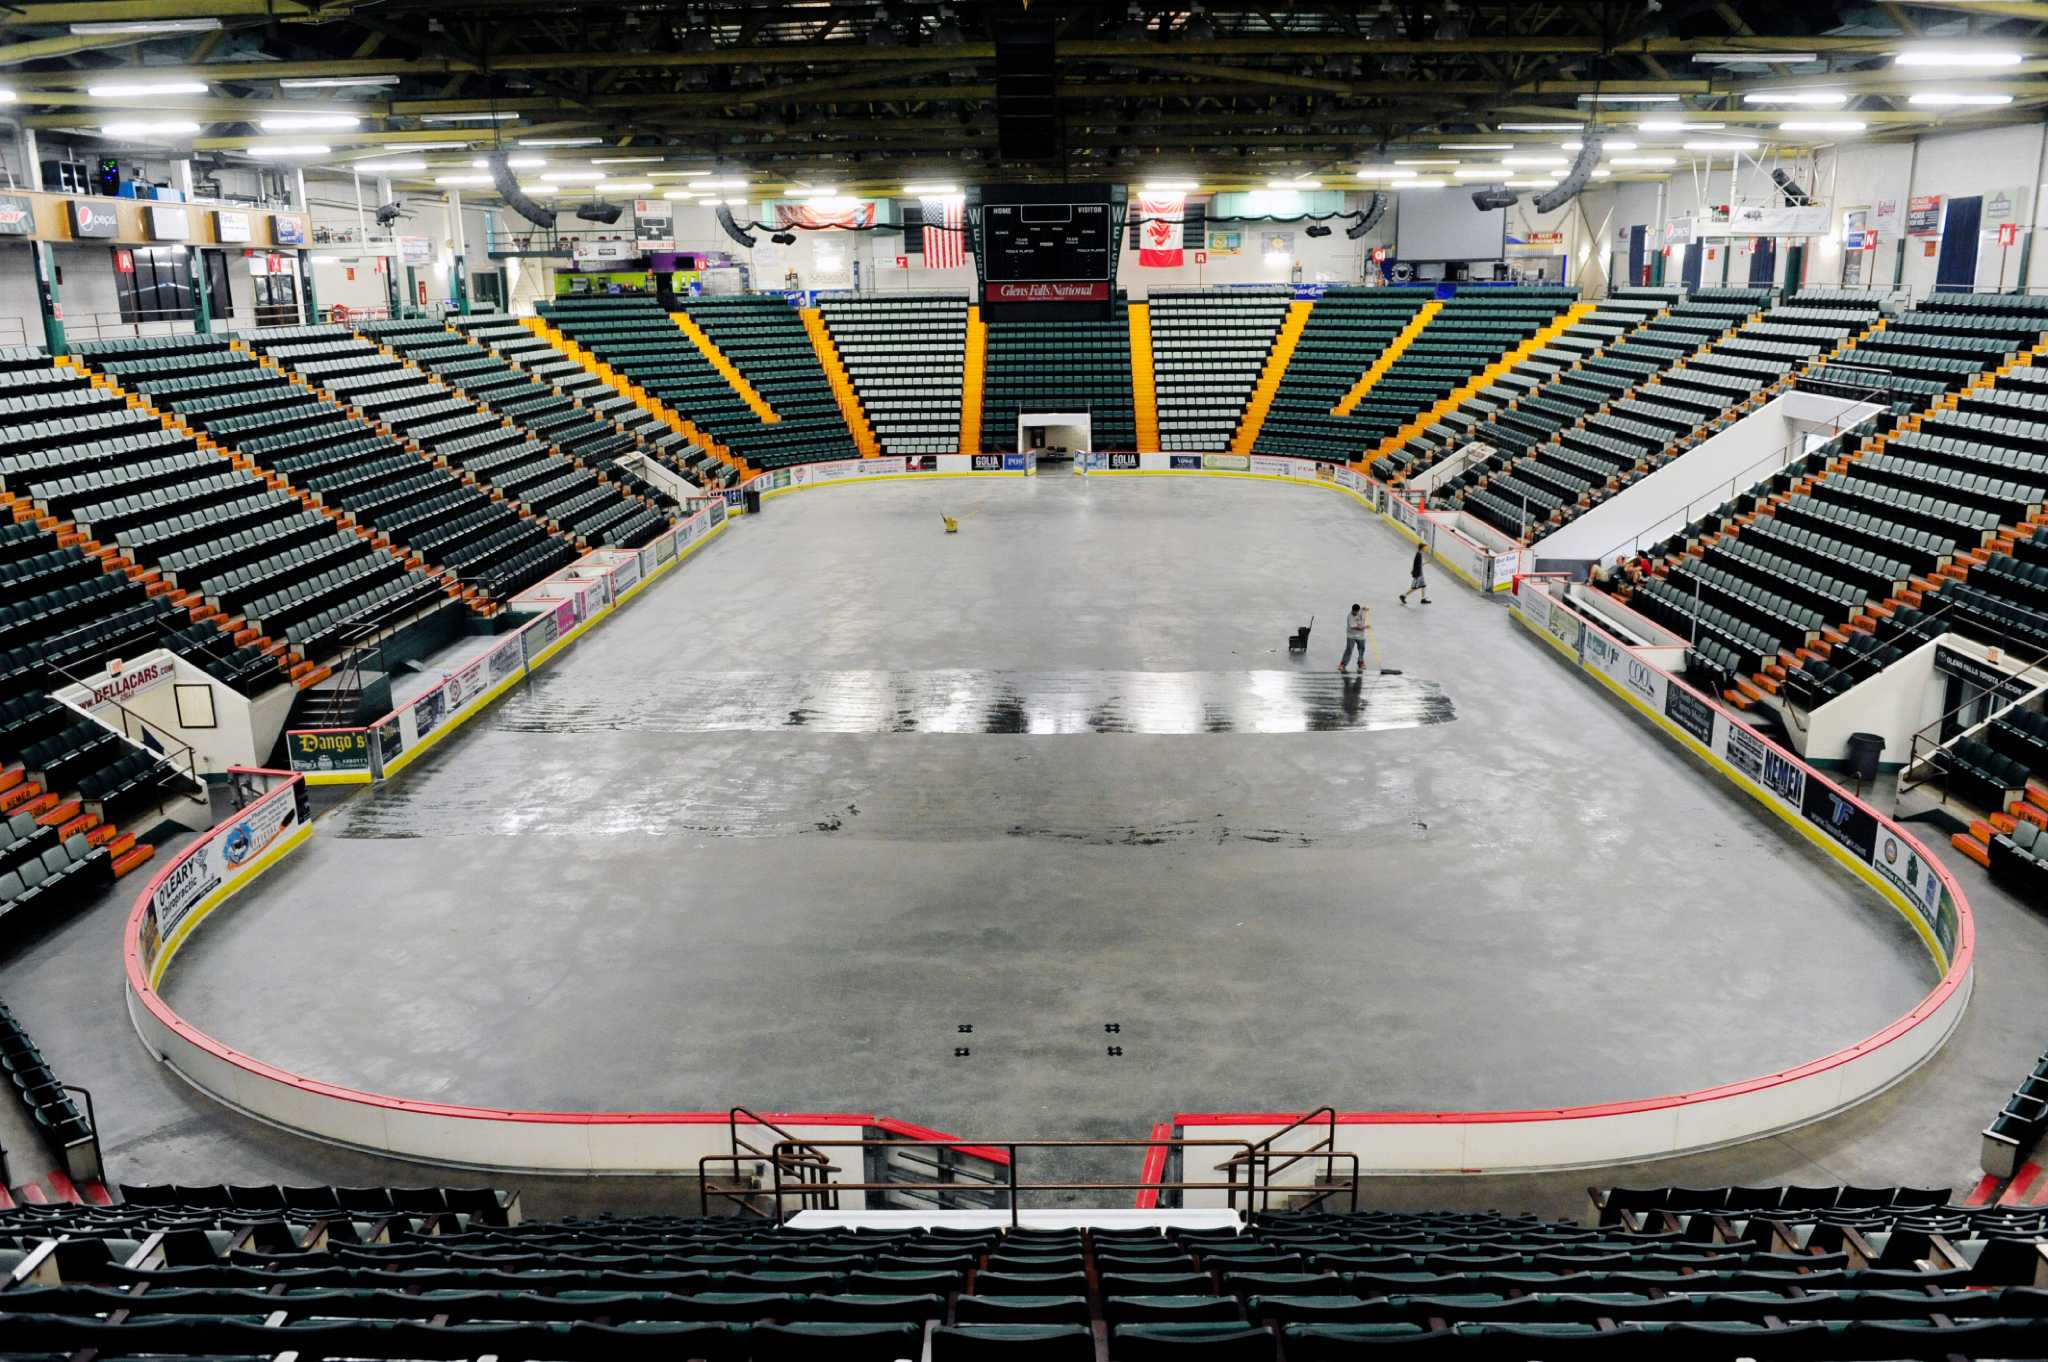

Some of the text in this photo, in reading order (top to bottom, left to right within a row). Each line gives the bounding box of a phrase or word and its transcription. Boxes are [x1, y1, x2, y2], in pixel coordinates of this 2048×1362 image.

[1866, 235, 1874, 245] N
[122, 255, 130, 268] A
[1000, 283, 1093, 296] Glens Falls National
[298, 733, 366, 752] Dango's
